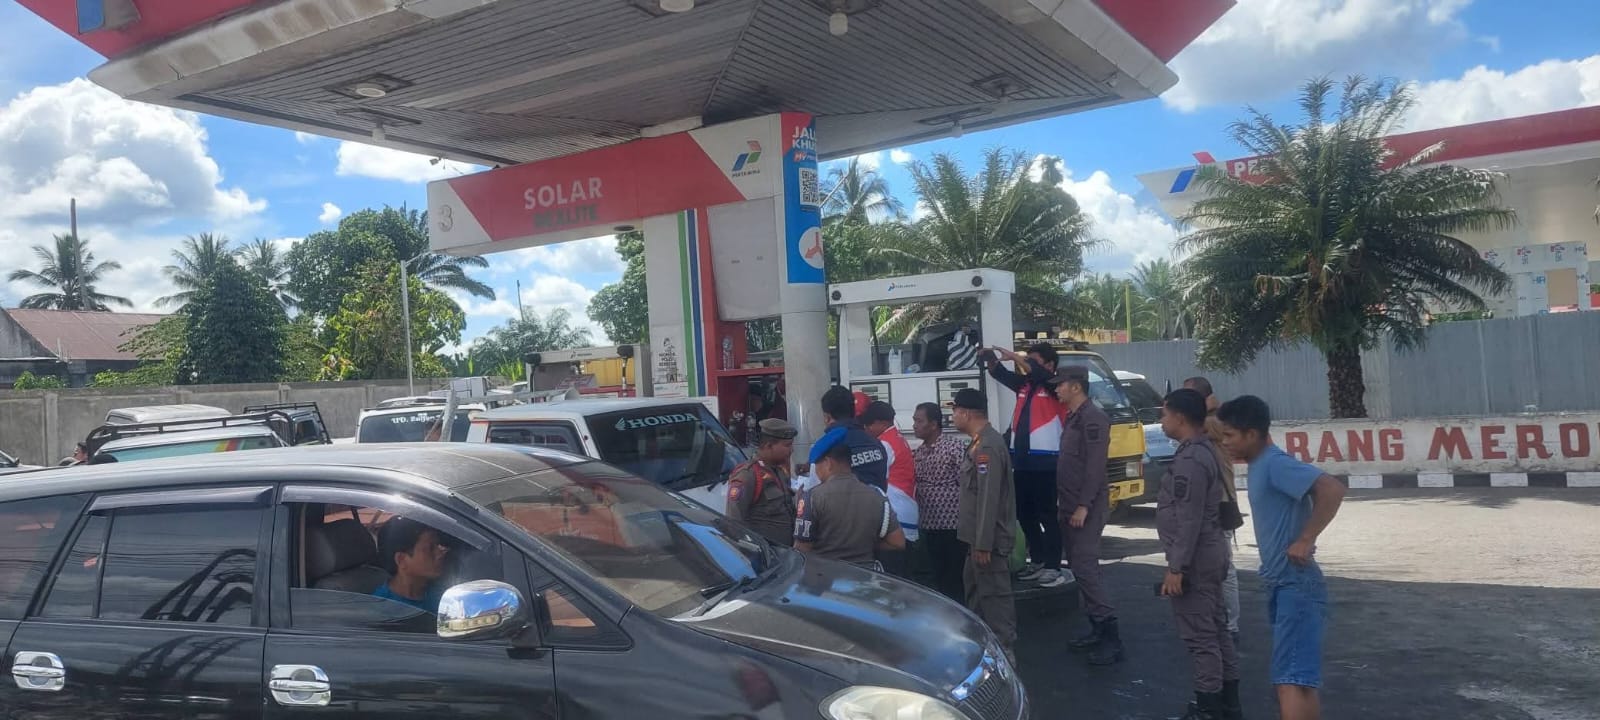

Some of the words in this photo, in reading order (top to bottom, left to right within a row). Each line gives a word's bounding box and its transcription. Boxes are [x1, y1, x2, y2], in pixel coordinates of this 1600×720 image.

[523, 177, 603, 210] SOLAR
[438, 204, 454, 232] 3
[627, 413, 699, 429] HONDA
[1427, 422, 1600, 461] MERO
